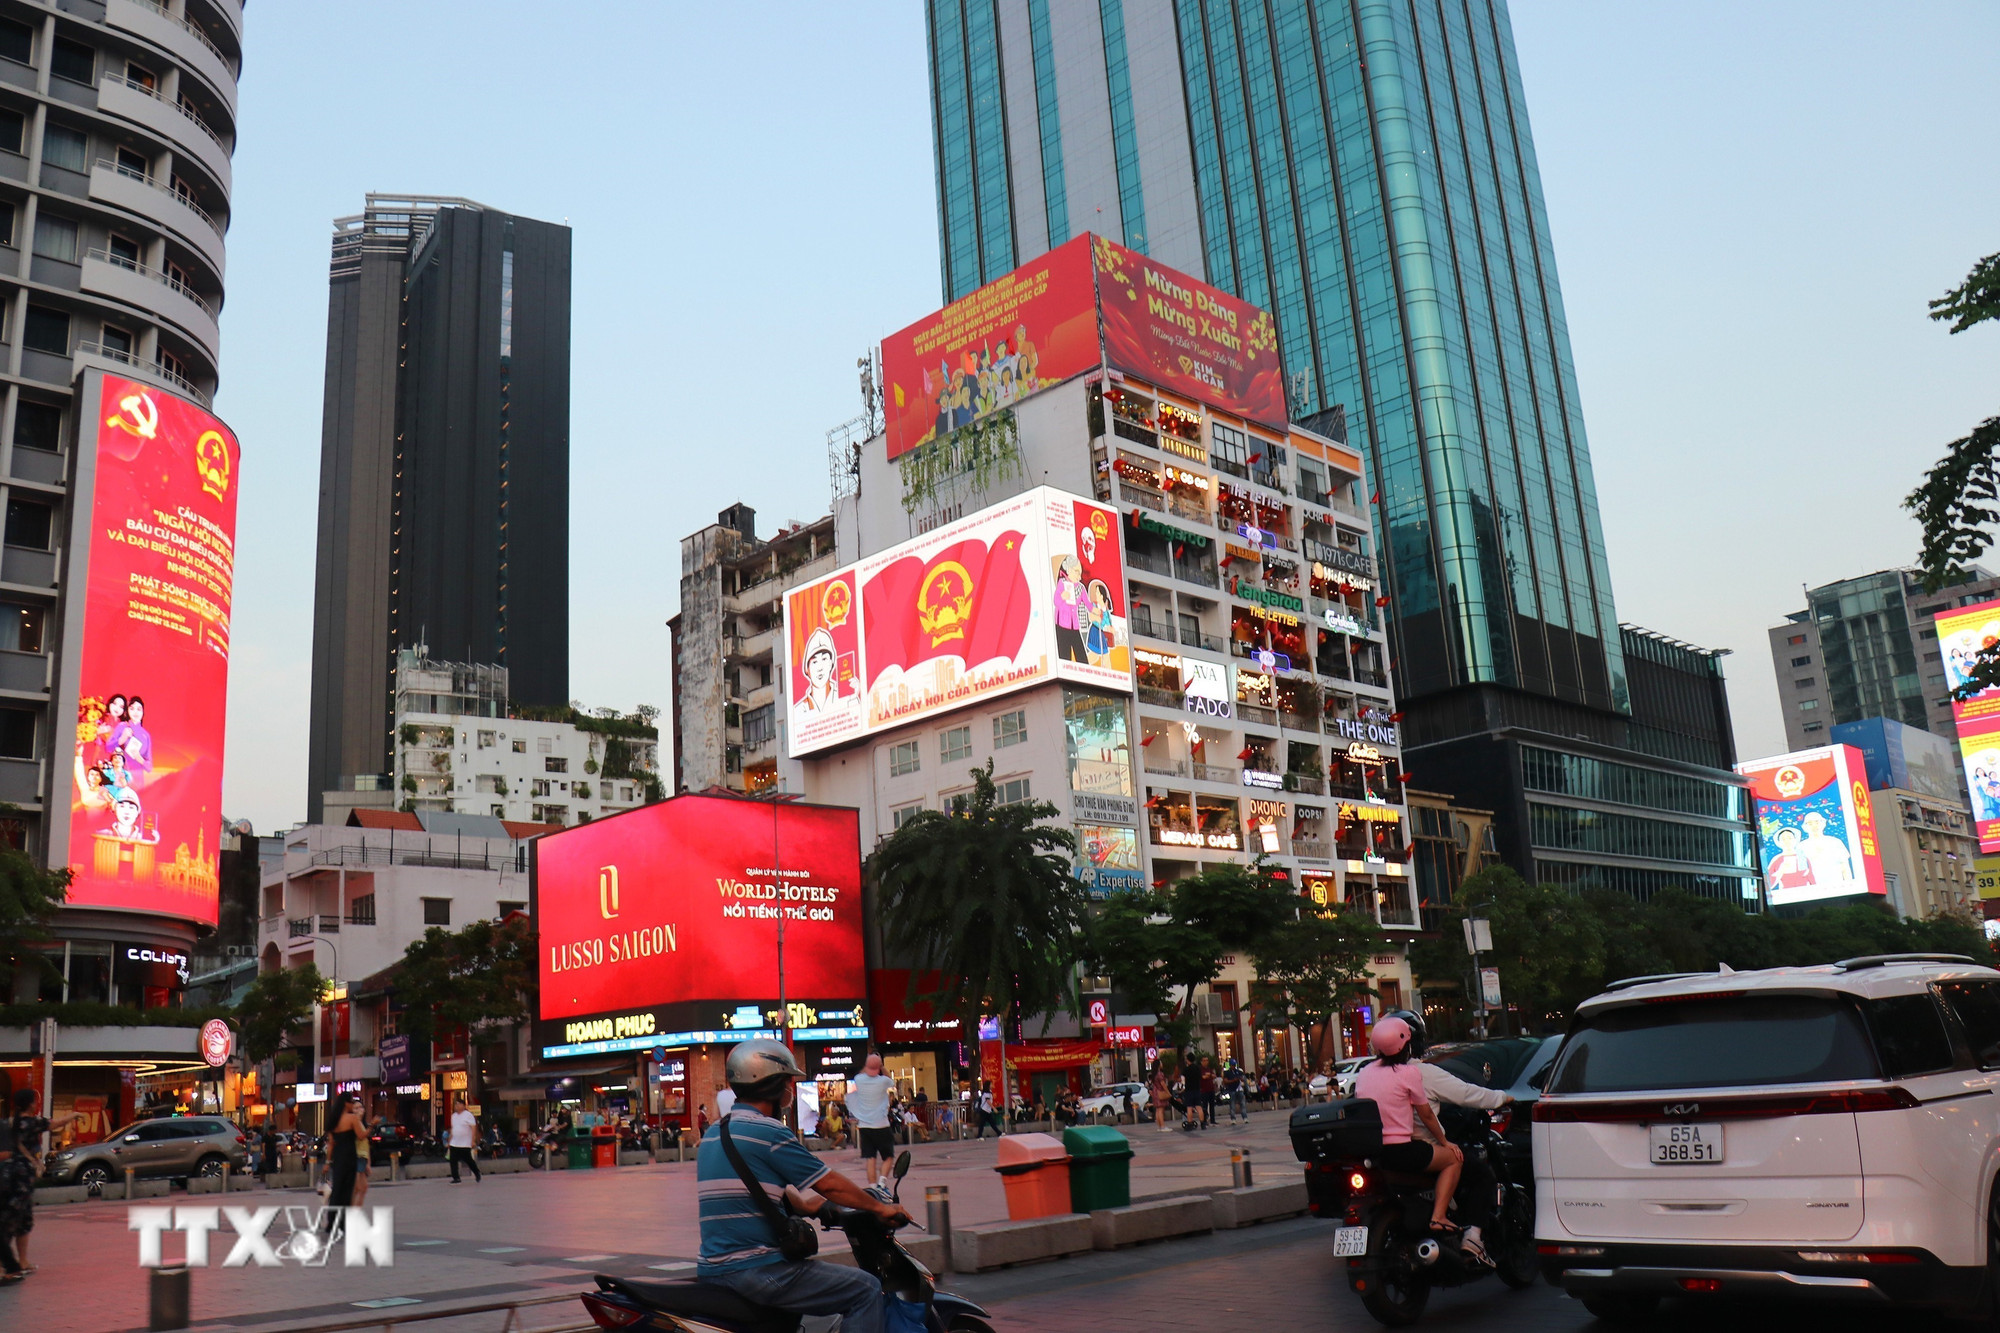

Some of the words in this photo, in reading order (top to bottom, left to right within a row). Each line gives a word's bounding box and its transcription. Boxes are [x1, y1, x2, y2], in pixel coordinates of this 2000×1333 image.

[1144, 266, 1193, 310] Mừng
[1196, 289, 1238, 332] Đảng
[1148, 293, 1196, 336] Mừng
[1199, 315, 1242, 352] Xuân
[1194, 360, 1213, 375] KIM
[1250, 490, 1284, 512] LETTER
[107, 528, 126, 542] VÀ
[130, 572, 161, 590] PHÁT
[162, 580, 189, 600] SÓNG
[1250, 604, 1266, 619] THE
[1268, 610, 1298, 627] LETTER
[1193, 665, 1217, 682] AVA
[878, 710, 891, 722] LÀ
[894, 698, 922, 717] NGÀY
[925, 693, 944, 708] HỘI
[947, 684, 970, 700] CỦA
[973, 675, 1005, 692] TOÀN
[1007, 664, 1038, 682] DÂN!
[1186, 695, 1231, 718] FADO
[1336, 718, 1364, 740] THE
[1367, 724, 1396, 745] ONE
[1298, 808, 1322, 820] OOPS!
[1357, 806, 1399, 823] DOWNTOWN
[1160, 830, 1204, 846] MERAKI
[746, 867, 763, 877] QUẢN
[771, 869, 782, 877] VN
[1099, 872, 1144, 891] Expertise
[724, 901, 746, 918] NỔI
[747, 902, 783, 919] TIẾNG
[784, 904, 808, 920] THẾ
[809, 906, 834, 921] GIỚI
[551, 937, 603, 974] LUSSO
[609, 922, 677, 963] SAIGON
[206, 1053, 226, 1065] COFFEE
[404, 1085, 415, 1094] BODY
[1663, 1103, 1700, 1116] KIA
[1670, 1126, 1701, 1143] 65A
[1658, 1144, 1713, 1161] 368.51
[1340, 1230, 1363, 1242] 59-C3
[1336, 1243, 1364, 1255] 277.02
